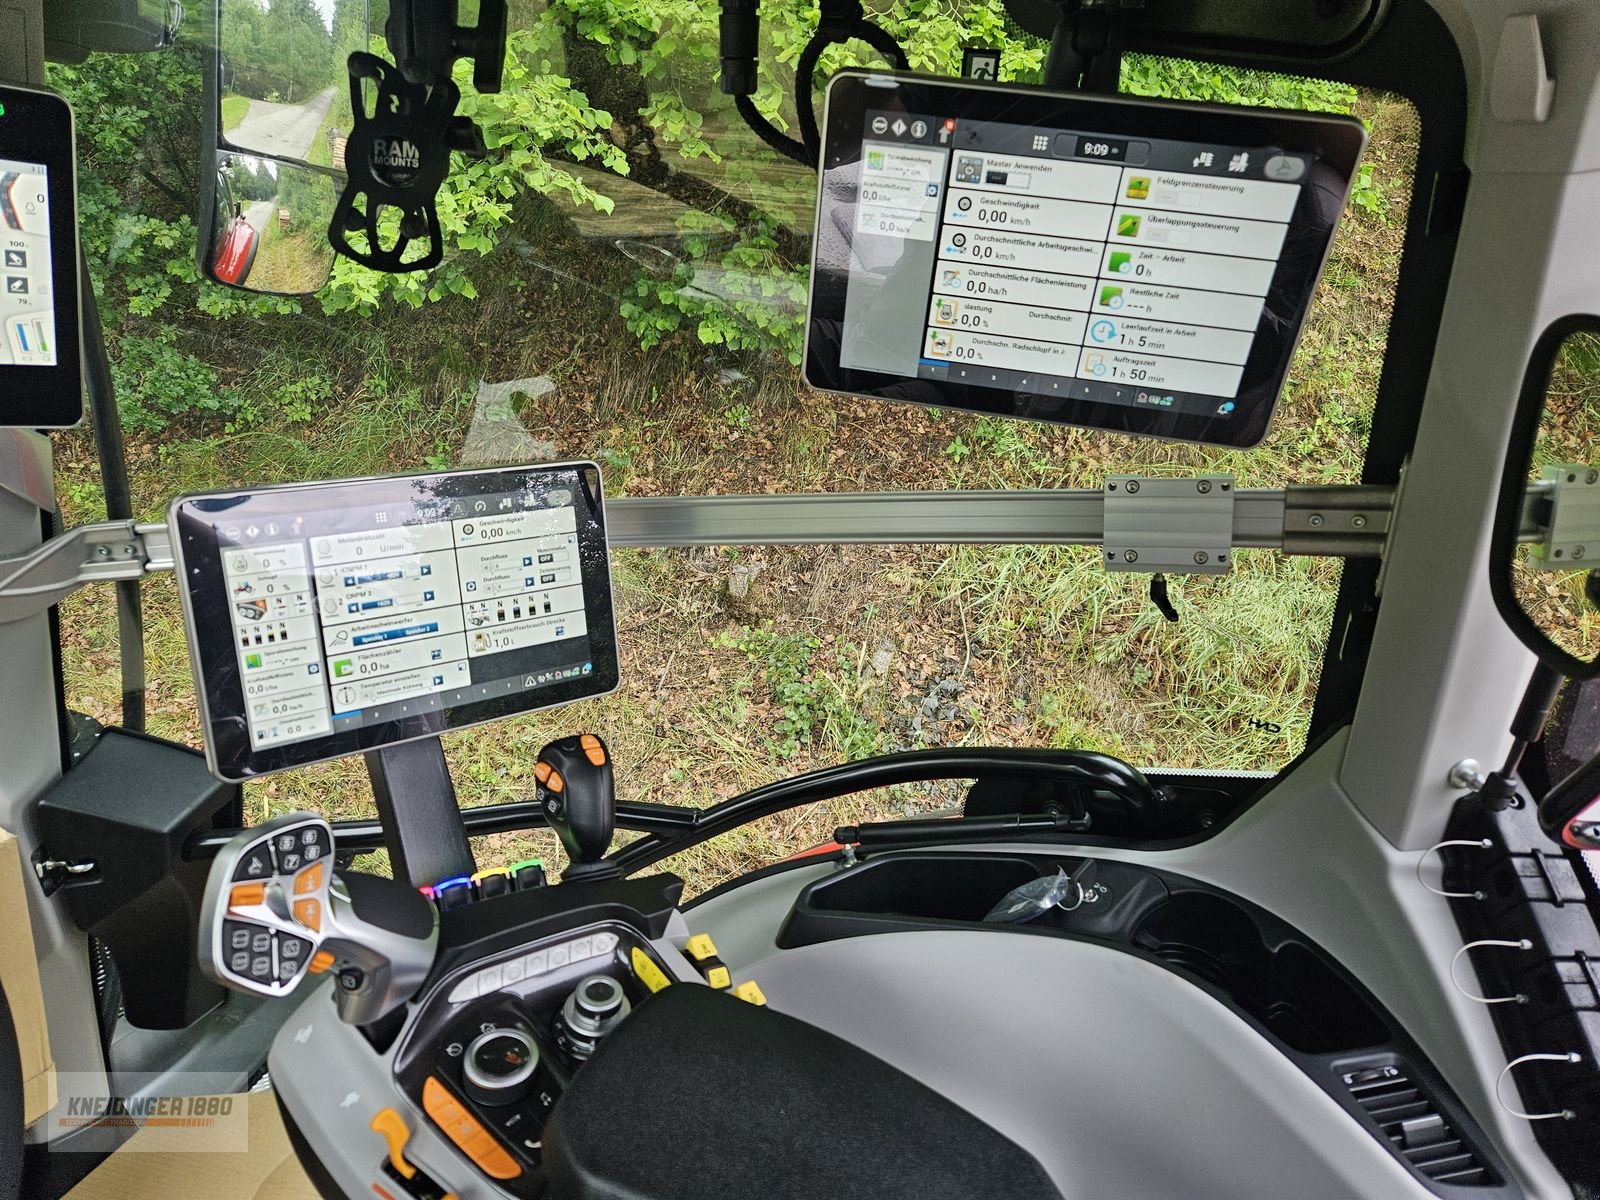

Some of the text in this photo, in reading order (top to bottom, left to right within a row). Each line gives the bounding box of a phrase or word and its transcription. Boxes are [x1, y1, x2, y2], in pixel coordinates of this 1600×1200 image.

[374, 139, 420, 159] RAM
[1084, 142, 1110, 156] 9:09
[374, 156, 419, 168] MOUNTS
[986, 159, 1052, 173] Master Anwenden
[1157, 176, 1245, 194] Feldgrenzensteuerung
[36, 193, 45, 204] 0
[862, 190, 878, 201] 0,0
[980, 197, 1040, 210] Geschwindigkeit
[978, 208, 1031, 227] 0,00 km/h
[1148, 215, 1240, 233] Überlappungssteuerung
[9, 240, 25, 248] 100
[974, 233, 1037, 248] Durchschnittliche
[972, 245, 1016, 262] 0,0 km/h
[1139, 251, 1153, 260] Zeit
[1162, 254, 1185, 264] Arbeit
[1135, 264, 1145, 277] 0
[968, 269, 1088, 291] Durchschnittliche Flächenleistung
[966, 280, 1008, 296] 0,0 ha/h
[1129, 288, 1180, 300] Restliche Zeit
[18, 298, 28, 306] 79
[961, 314, 981, 328] 0,0
[1121, 323, 1163, 335] Leerlaufzeit
[1174, 328, 1197, 338] Arbeit
[972, 337, 1010, 349] Durchschn.
[1012, 342, 1051, 355] Radschlupf
[1119, 334, 1165, 350] 1 h 5 min
[956, 346, 975, 360] 0,0
[1113, 355, 1156, 368] Auftragszeit
[1111, 366, 1165, 383] 1 h 50 min
[481, 528, 503, 540] 0,00
[356, 544, 404, 556] 0 U/min
[540, 554, 551, 562] OFF
[267, 584, 274, 594] 0
[492, 621, 545, 636] Kraftstoffverbrauch
[495, 637, 509, 649] 1,0
[357, 648, 402, 661] Flächenzähler
[360, 662, 390, 675] 0,0 ha
[248, 684, 264, 695] 0,0
[272, 703, 288, 714] 0,0
